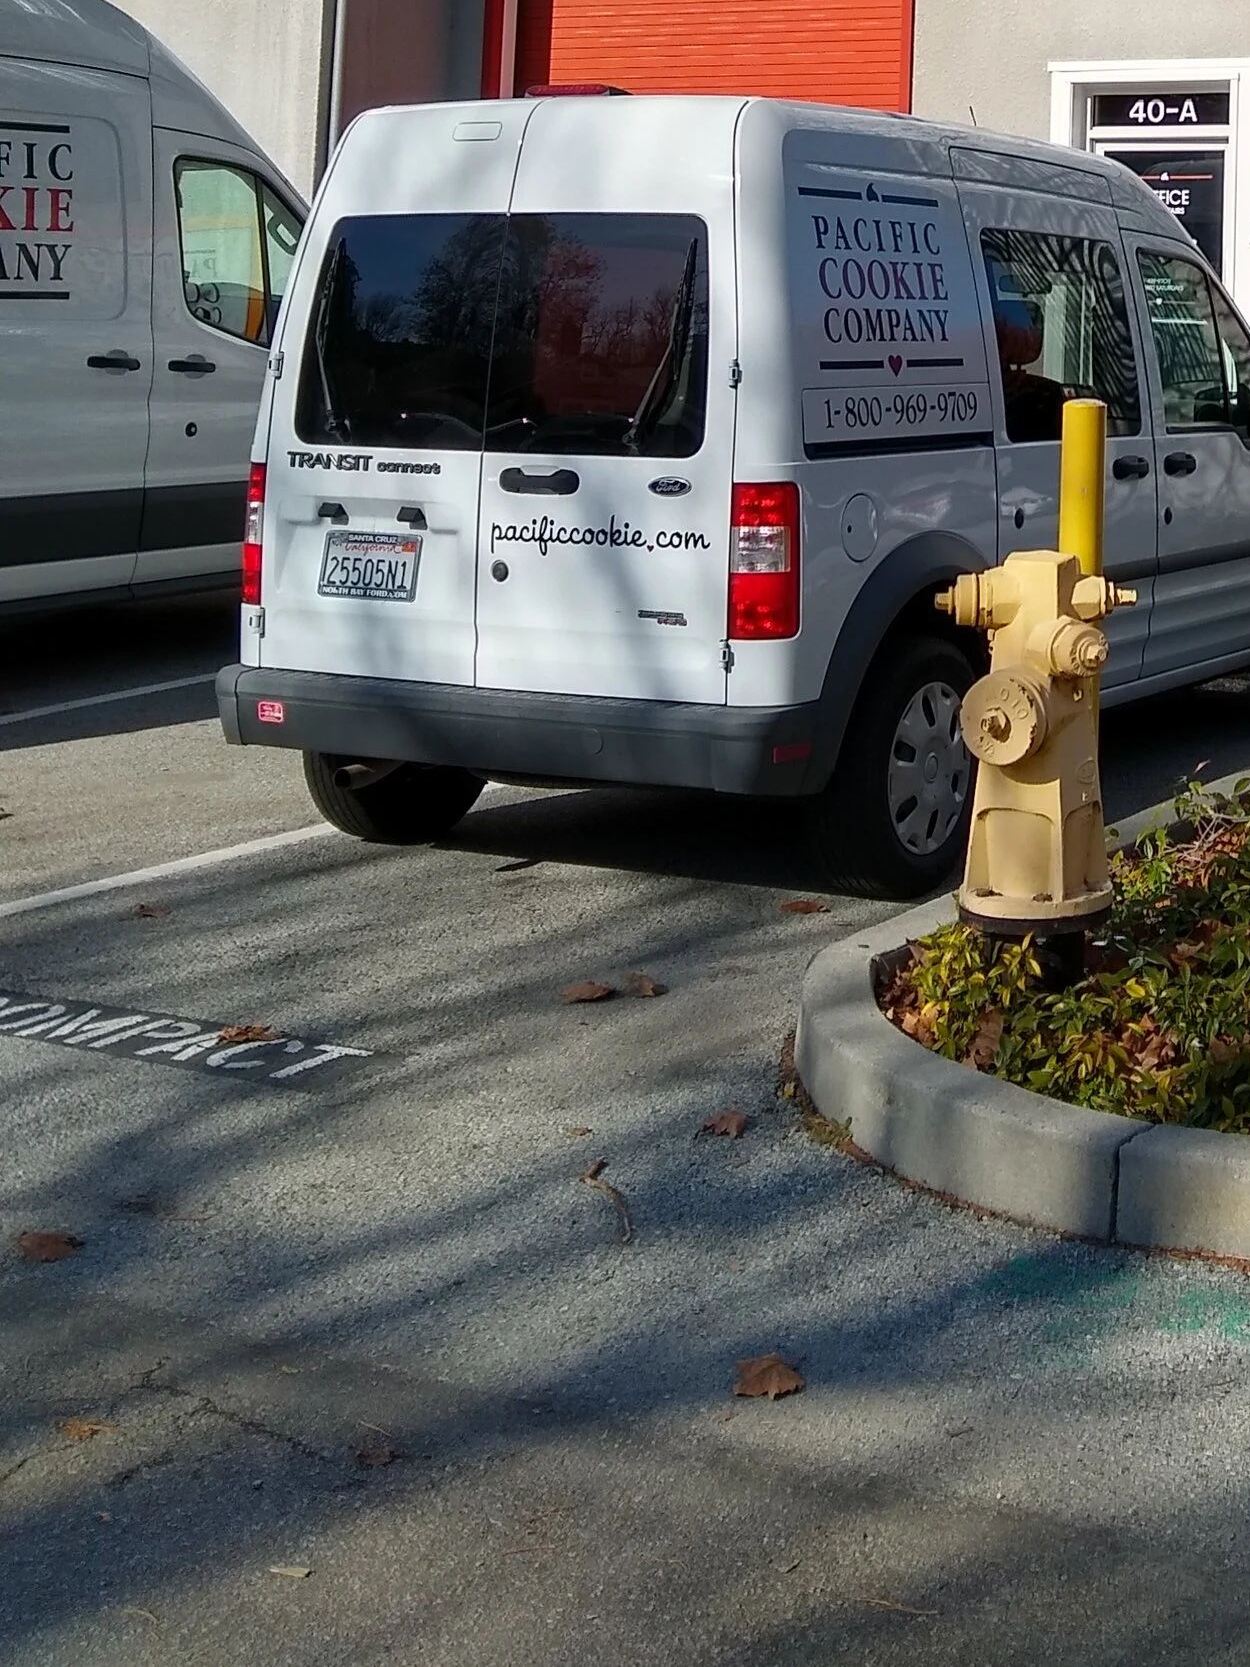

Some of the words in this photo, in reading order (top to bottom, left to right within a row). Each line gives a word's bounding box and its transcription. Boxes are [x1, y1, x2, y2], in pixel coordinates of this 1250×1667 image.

[1129, 99, 1198, 123] 40-A
[811, 214, 941, 255] PACIFIC
[818, 257, 949, 301] COOKIE
[823, 307, 950, 344] COMPANY
[824, 391, 978, 429] 1-800-969-9709
[287, 450, 373, 472] TRANSIT
[376, 460, 441, 475] connect
[348, 534, 374, 542] SANTA
[375, 535, 397, 544] CRUZ
[326, 556, 408, 590] 25505N1
[0, 997, 374, 1079] OMPACT
